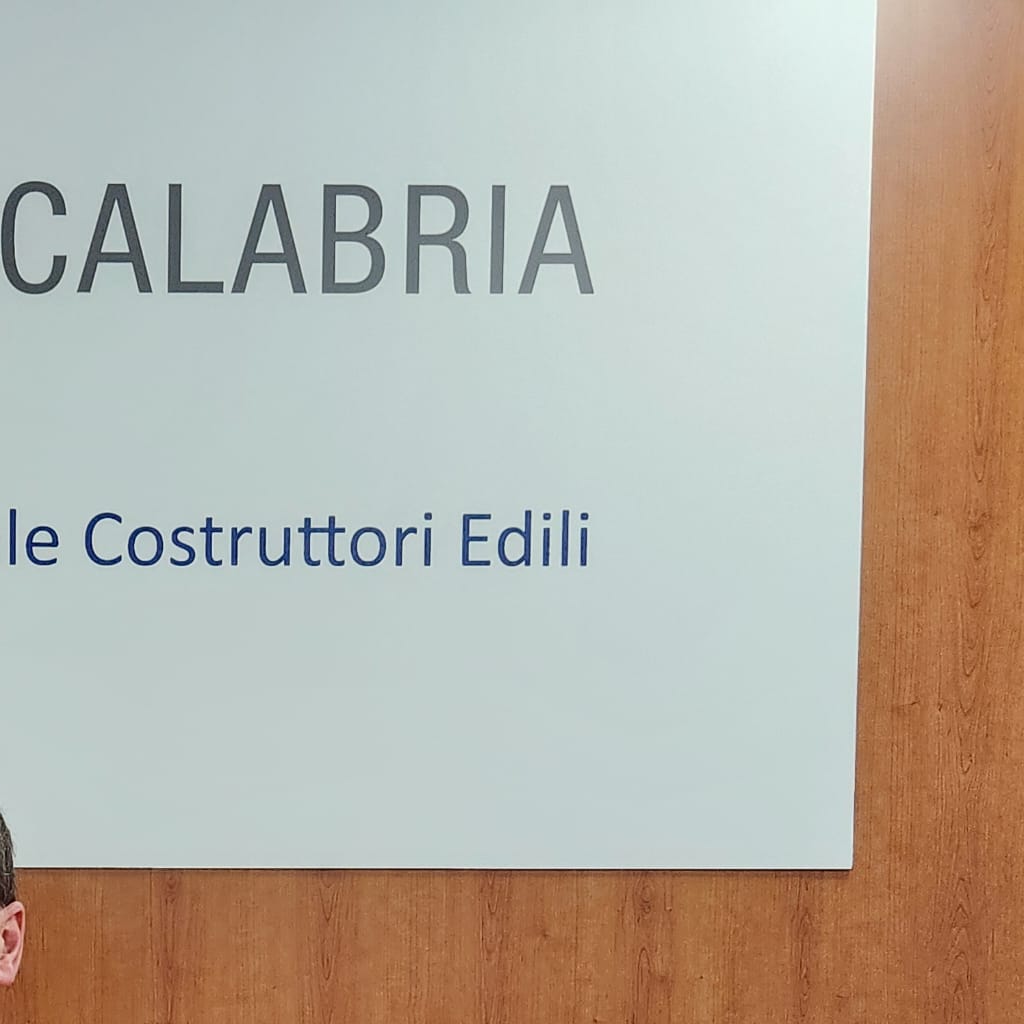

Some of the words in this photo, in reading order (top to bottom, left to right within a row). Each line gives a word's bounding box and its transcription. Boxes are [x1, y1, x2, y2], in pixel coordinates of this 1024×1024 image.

[1, 181, 594, 294] CALABRIA
[85, 512, 432, 566] Costruttori
[462, 510, 589, 566] Edili
